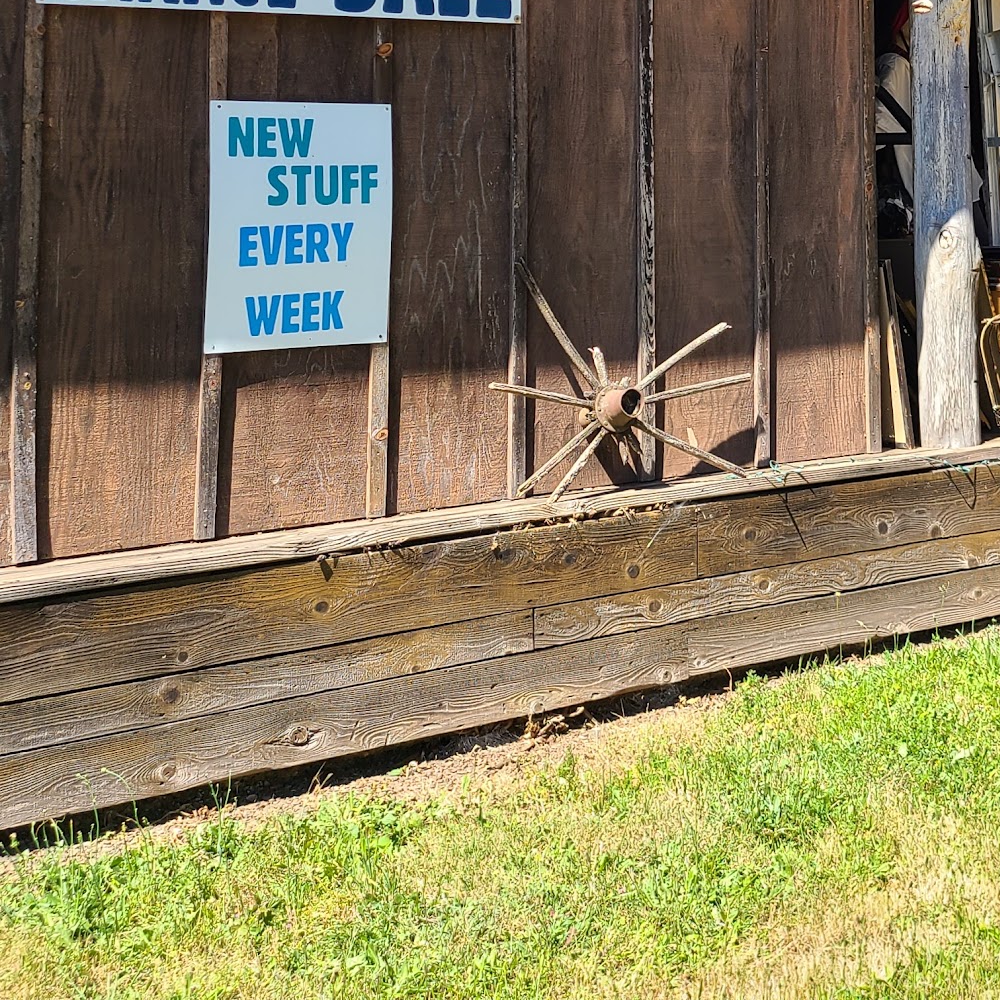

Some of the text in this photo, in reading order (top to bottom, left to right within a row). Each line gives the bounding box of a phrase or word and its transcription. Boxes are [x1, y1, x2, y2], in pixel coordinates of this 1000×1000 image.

[228, 116, 315, 158] NEW
[267, 164, 379, 207] STUFF
[238, 222, 355, 268] EVERY
[245, 290, 345, 337] WEEK
